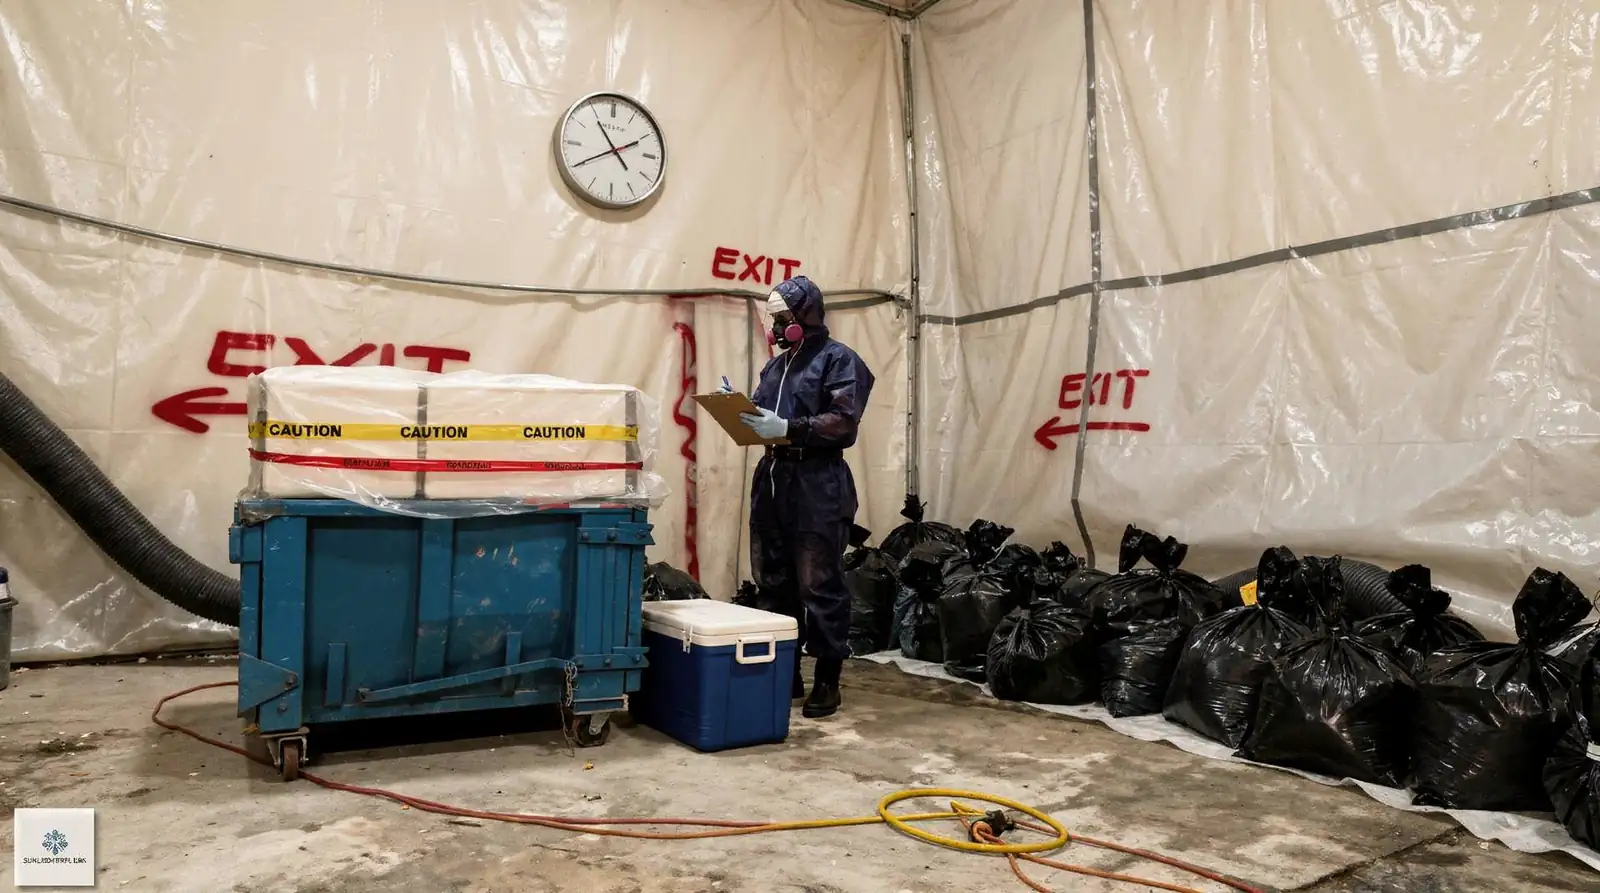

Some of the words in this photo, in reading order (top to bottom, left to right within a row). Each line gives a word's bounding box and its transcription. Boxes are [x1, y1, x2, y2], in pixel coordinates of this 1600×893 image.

[712, 246, 801, 285] EXIT
[269, 424, 342, 437] CAUTION
[400, 426, 468, 438] CAUTION
[523, 426, 586, 438] CAUTION
